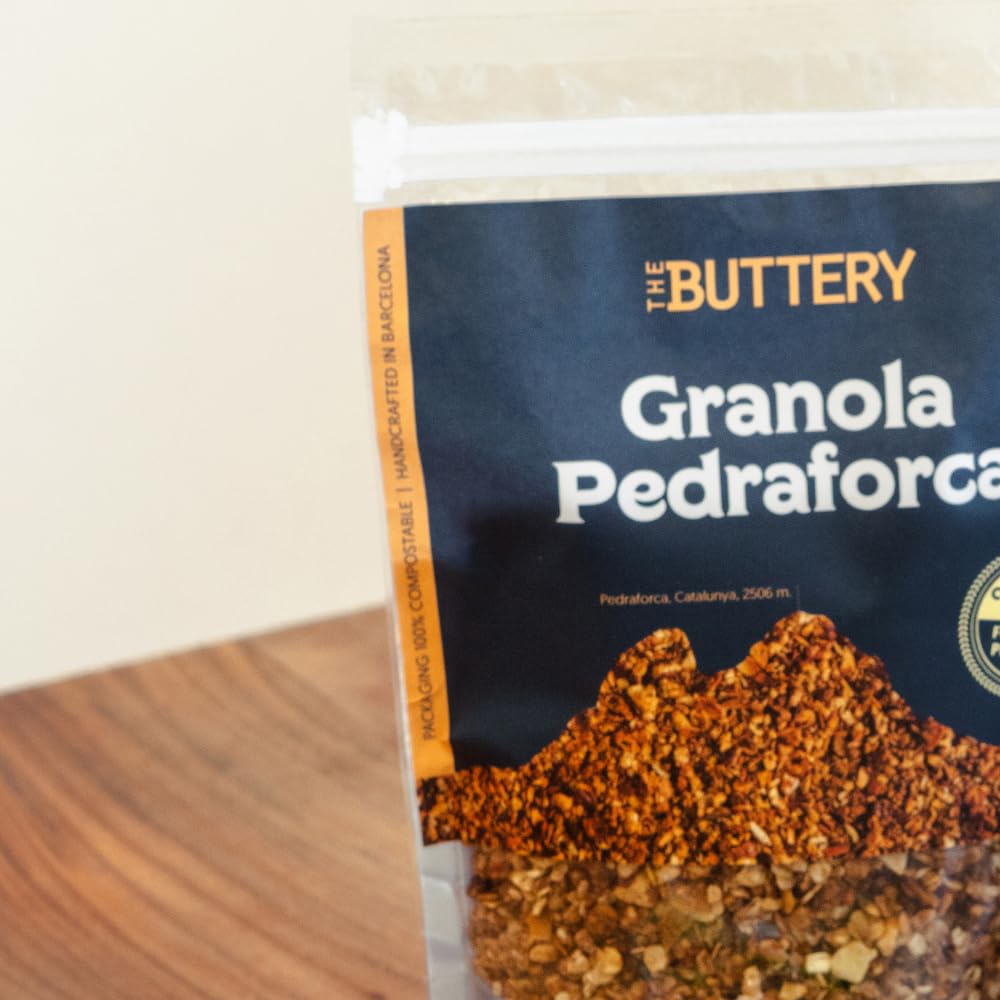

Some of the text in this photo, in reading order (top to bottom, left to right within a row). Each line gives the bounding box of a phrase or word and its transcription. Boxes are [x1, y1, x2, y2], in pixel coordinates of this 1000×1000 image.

[646, 248, 917, 313] THE BUTTERY
[377, 244, 408, 480] HANDCRAFTED IN BARCELONA
[620, 358, 956, 442] Granola
[399, 500, 438, 741] PACKAGING 100% COMPOSTABLE
[742, 587, 773, 600] 2506
